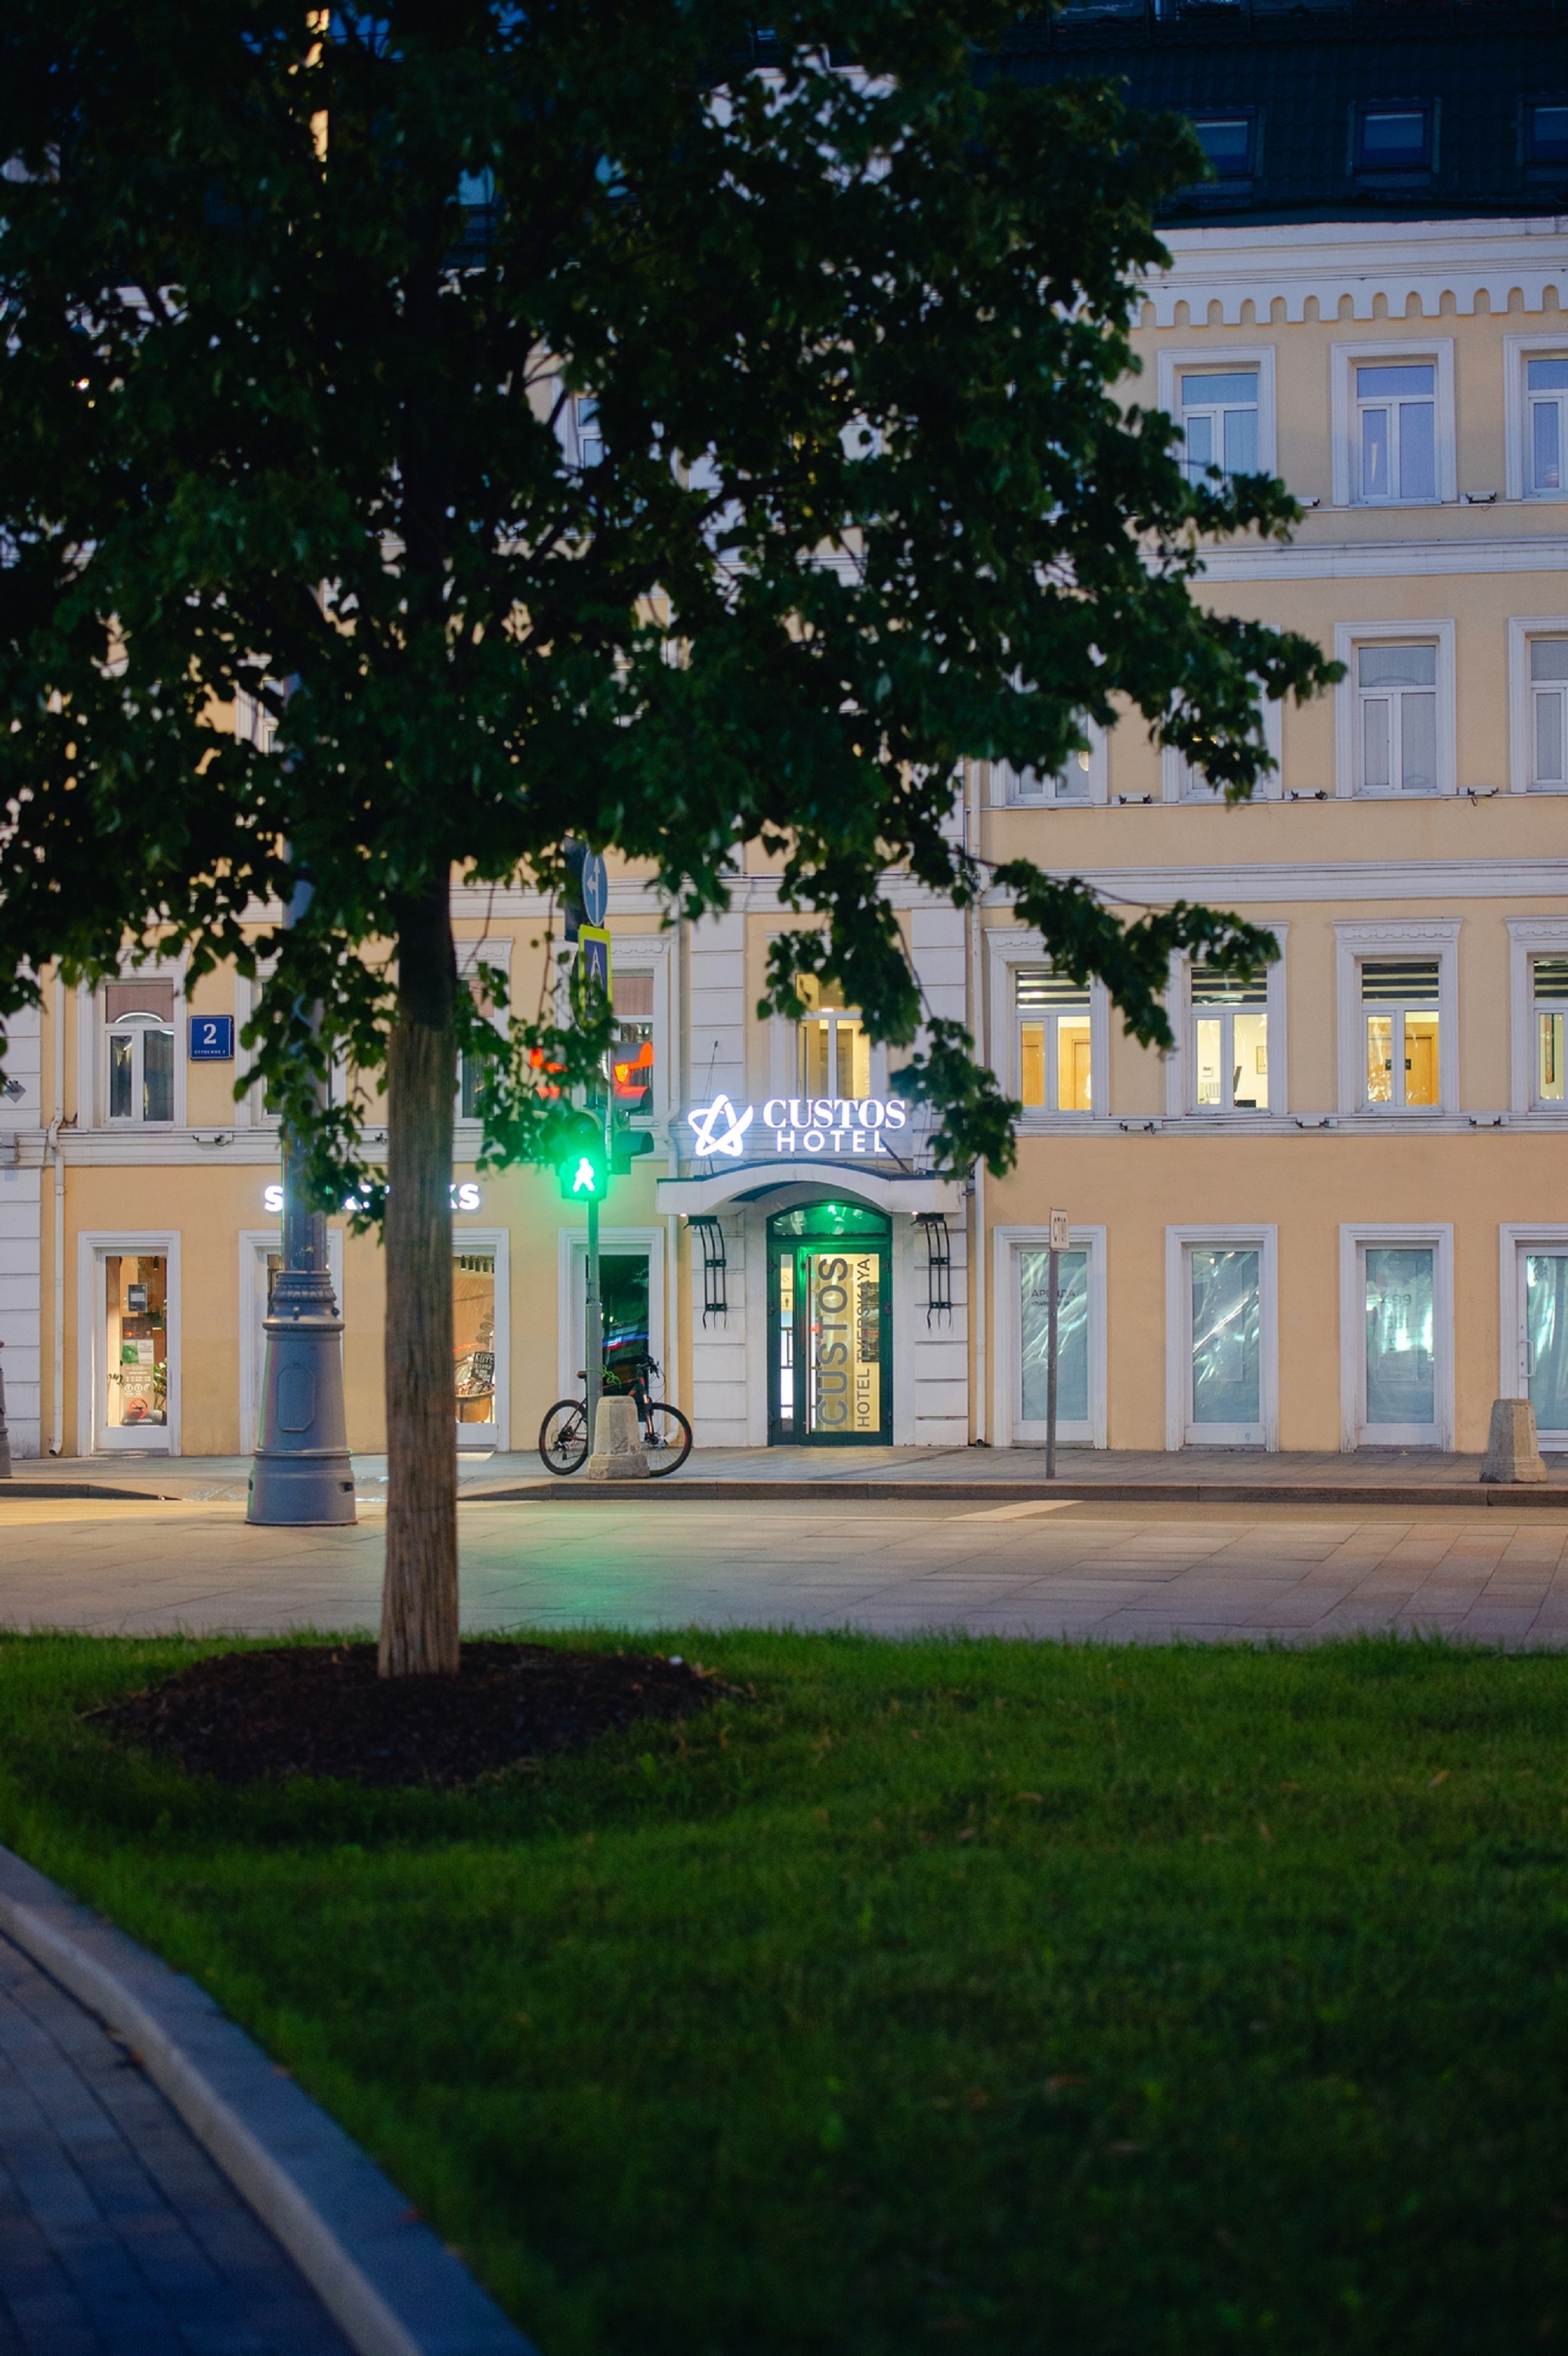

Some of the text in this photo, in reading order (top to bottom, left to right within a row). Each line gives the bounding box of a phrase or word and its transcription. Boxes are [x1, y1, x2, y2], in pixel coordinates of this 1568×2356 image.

[203, 1023, 216, 1044] 2
[763, 1099, 906, 1129] CUSTOS
[776, 1130, 887, 1153] HOTEL
[1032, 1289, 1076, 1298] АРЕДА
[817, 1258, 848, 1426] CUSTOS
[857, 1258, 870, 1428] HOTEL TVERSKAYA
